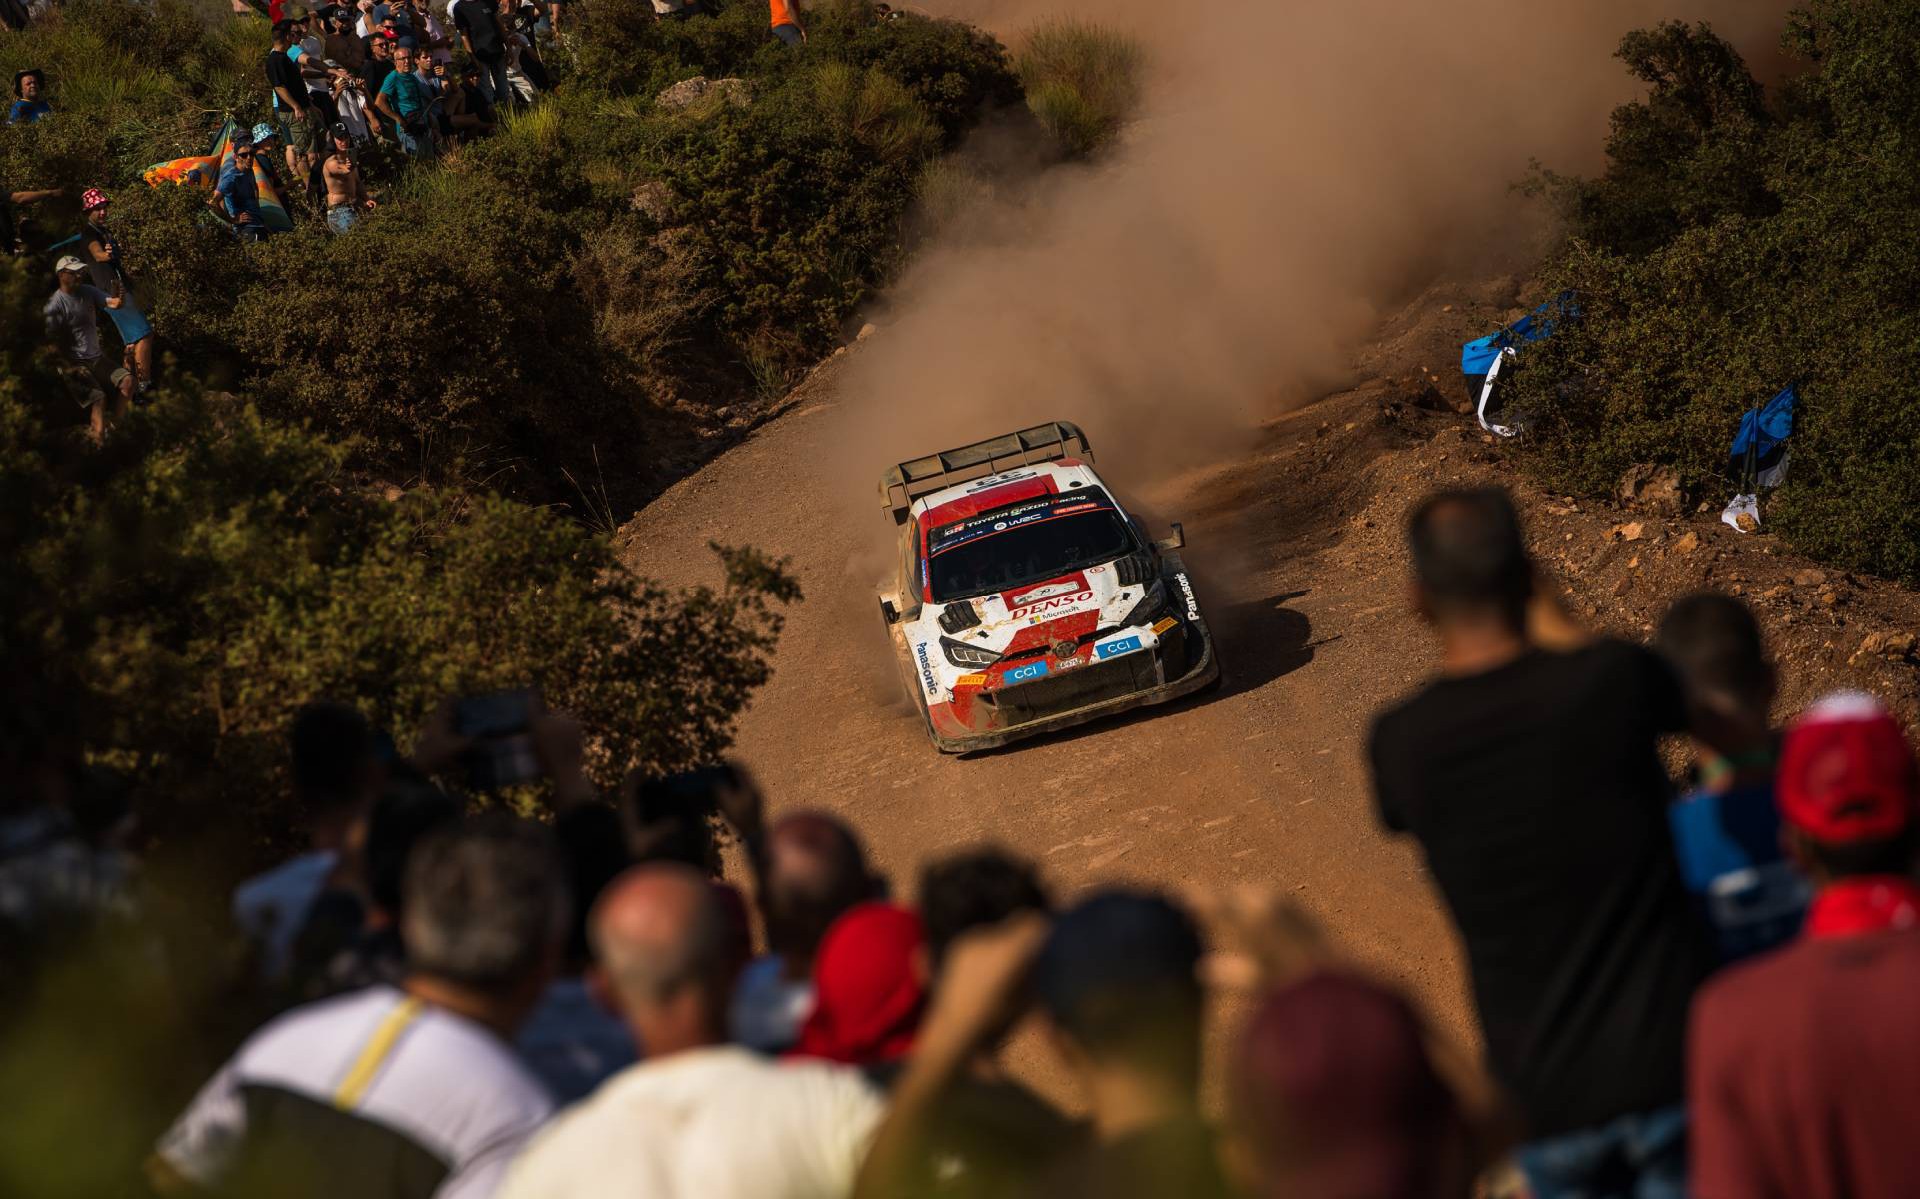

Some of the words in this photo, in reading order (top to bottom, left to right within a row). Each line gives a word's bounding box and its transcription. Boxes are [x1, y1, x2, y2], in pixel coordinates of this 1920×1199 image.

[966, 512, 1009, 528] TOYOTA
[1010, 502, 1049, 517] GAZOO
[1051, 495, 1087, 504] Racing
[1008, 514, 1042, 526] WRC
[1011, 591, 1094, 620] DENSO
[1174, 572, 1200, 621] Panasonic
[1042, 605, 1080, 620] Microsoft
[1107, 640, 1131, 654] CCI
[916, 641, 938, 695] Panasonic
[1014, 667, 1037, 679] CCI
